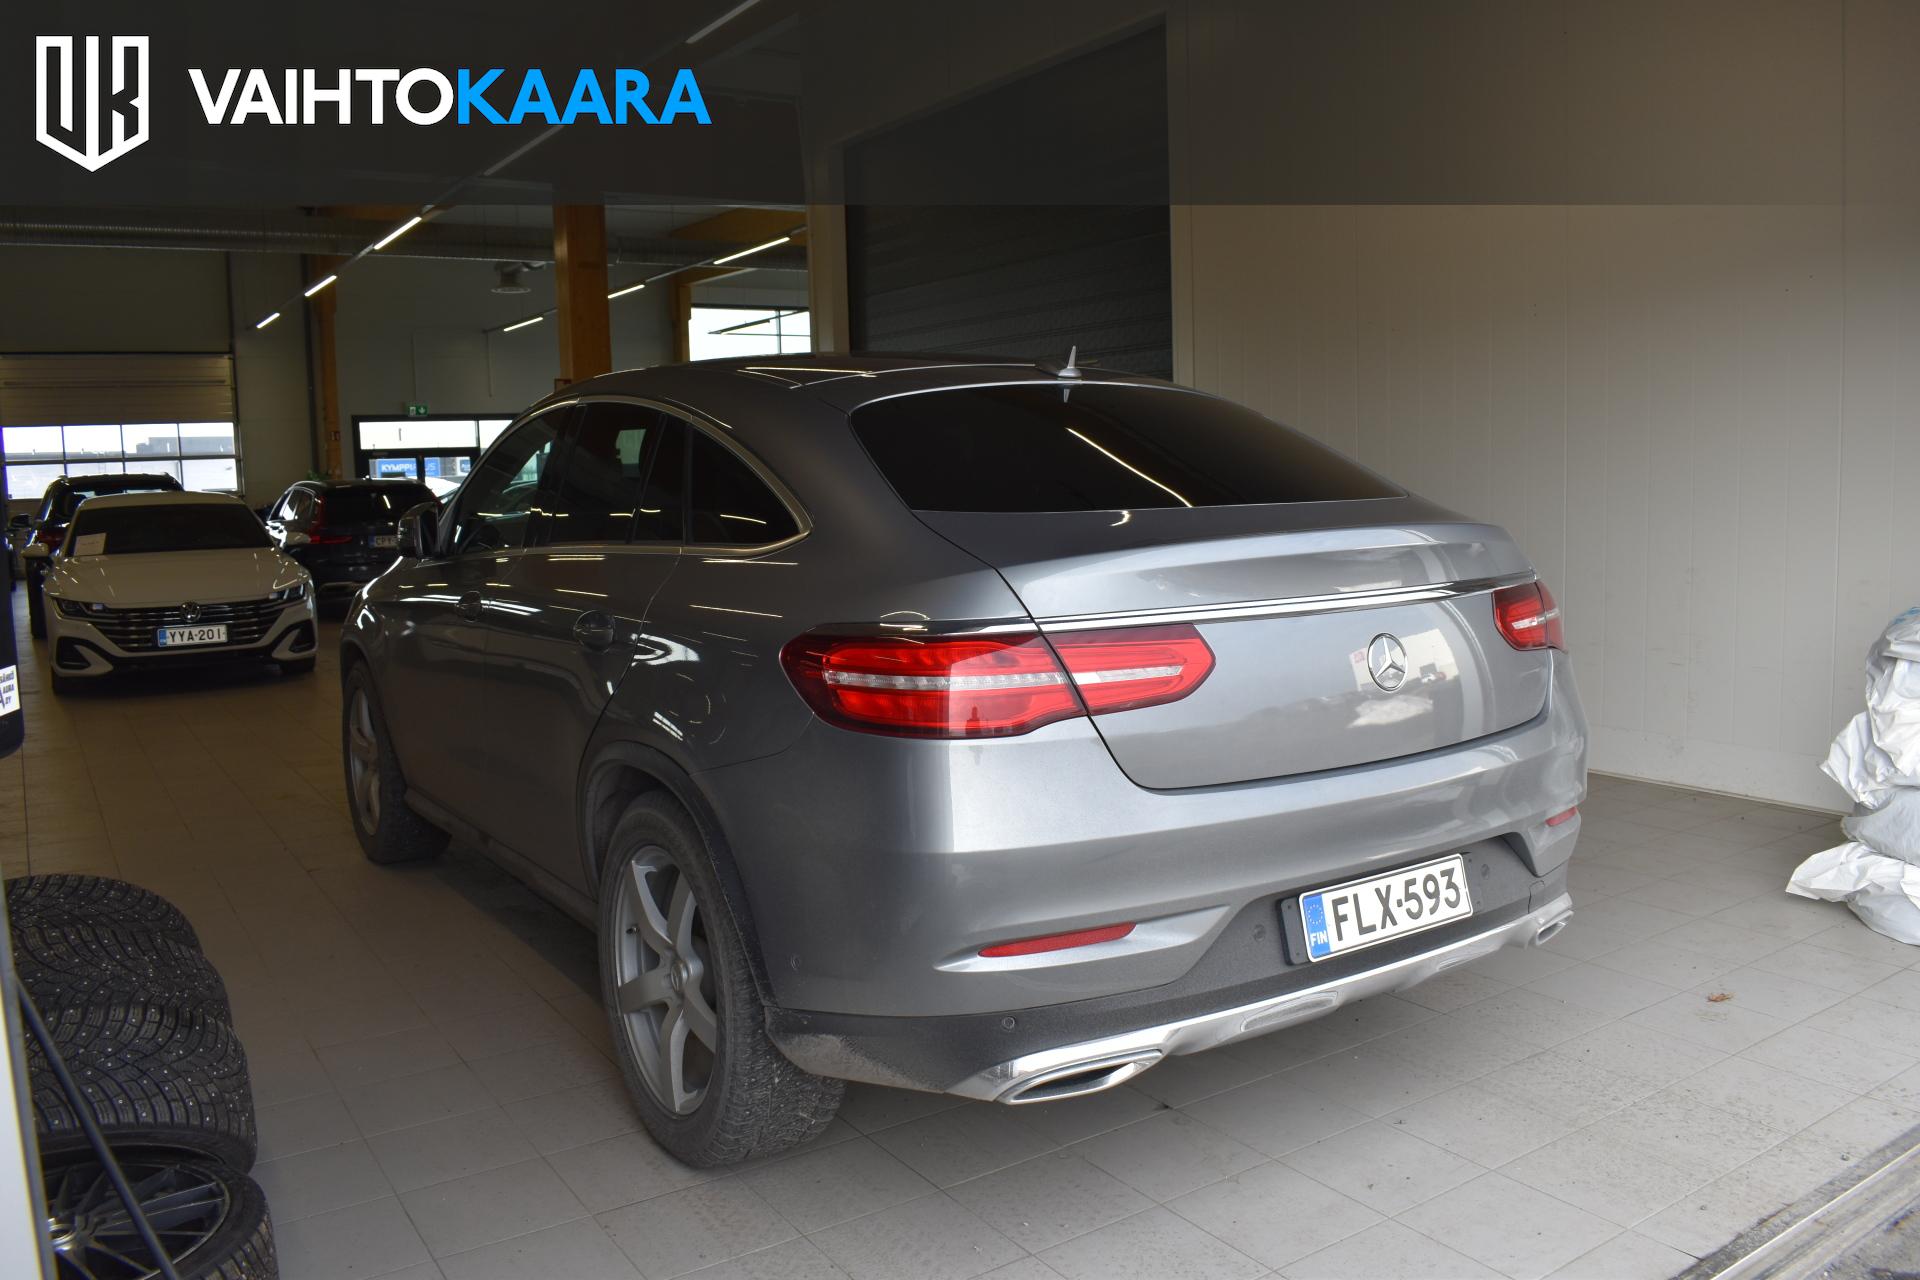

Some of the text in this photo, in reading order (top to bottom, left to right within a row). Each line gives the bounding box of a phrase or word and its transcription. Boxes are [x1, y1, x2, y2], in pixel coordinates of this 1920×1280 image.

[169, 628, 222, 643] YYA-201
[1331, 867, 1461, 942] FLX-593
[1310, 930, 1328, 946] FIN
